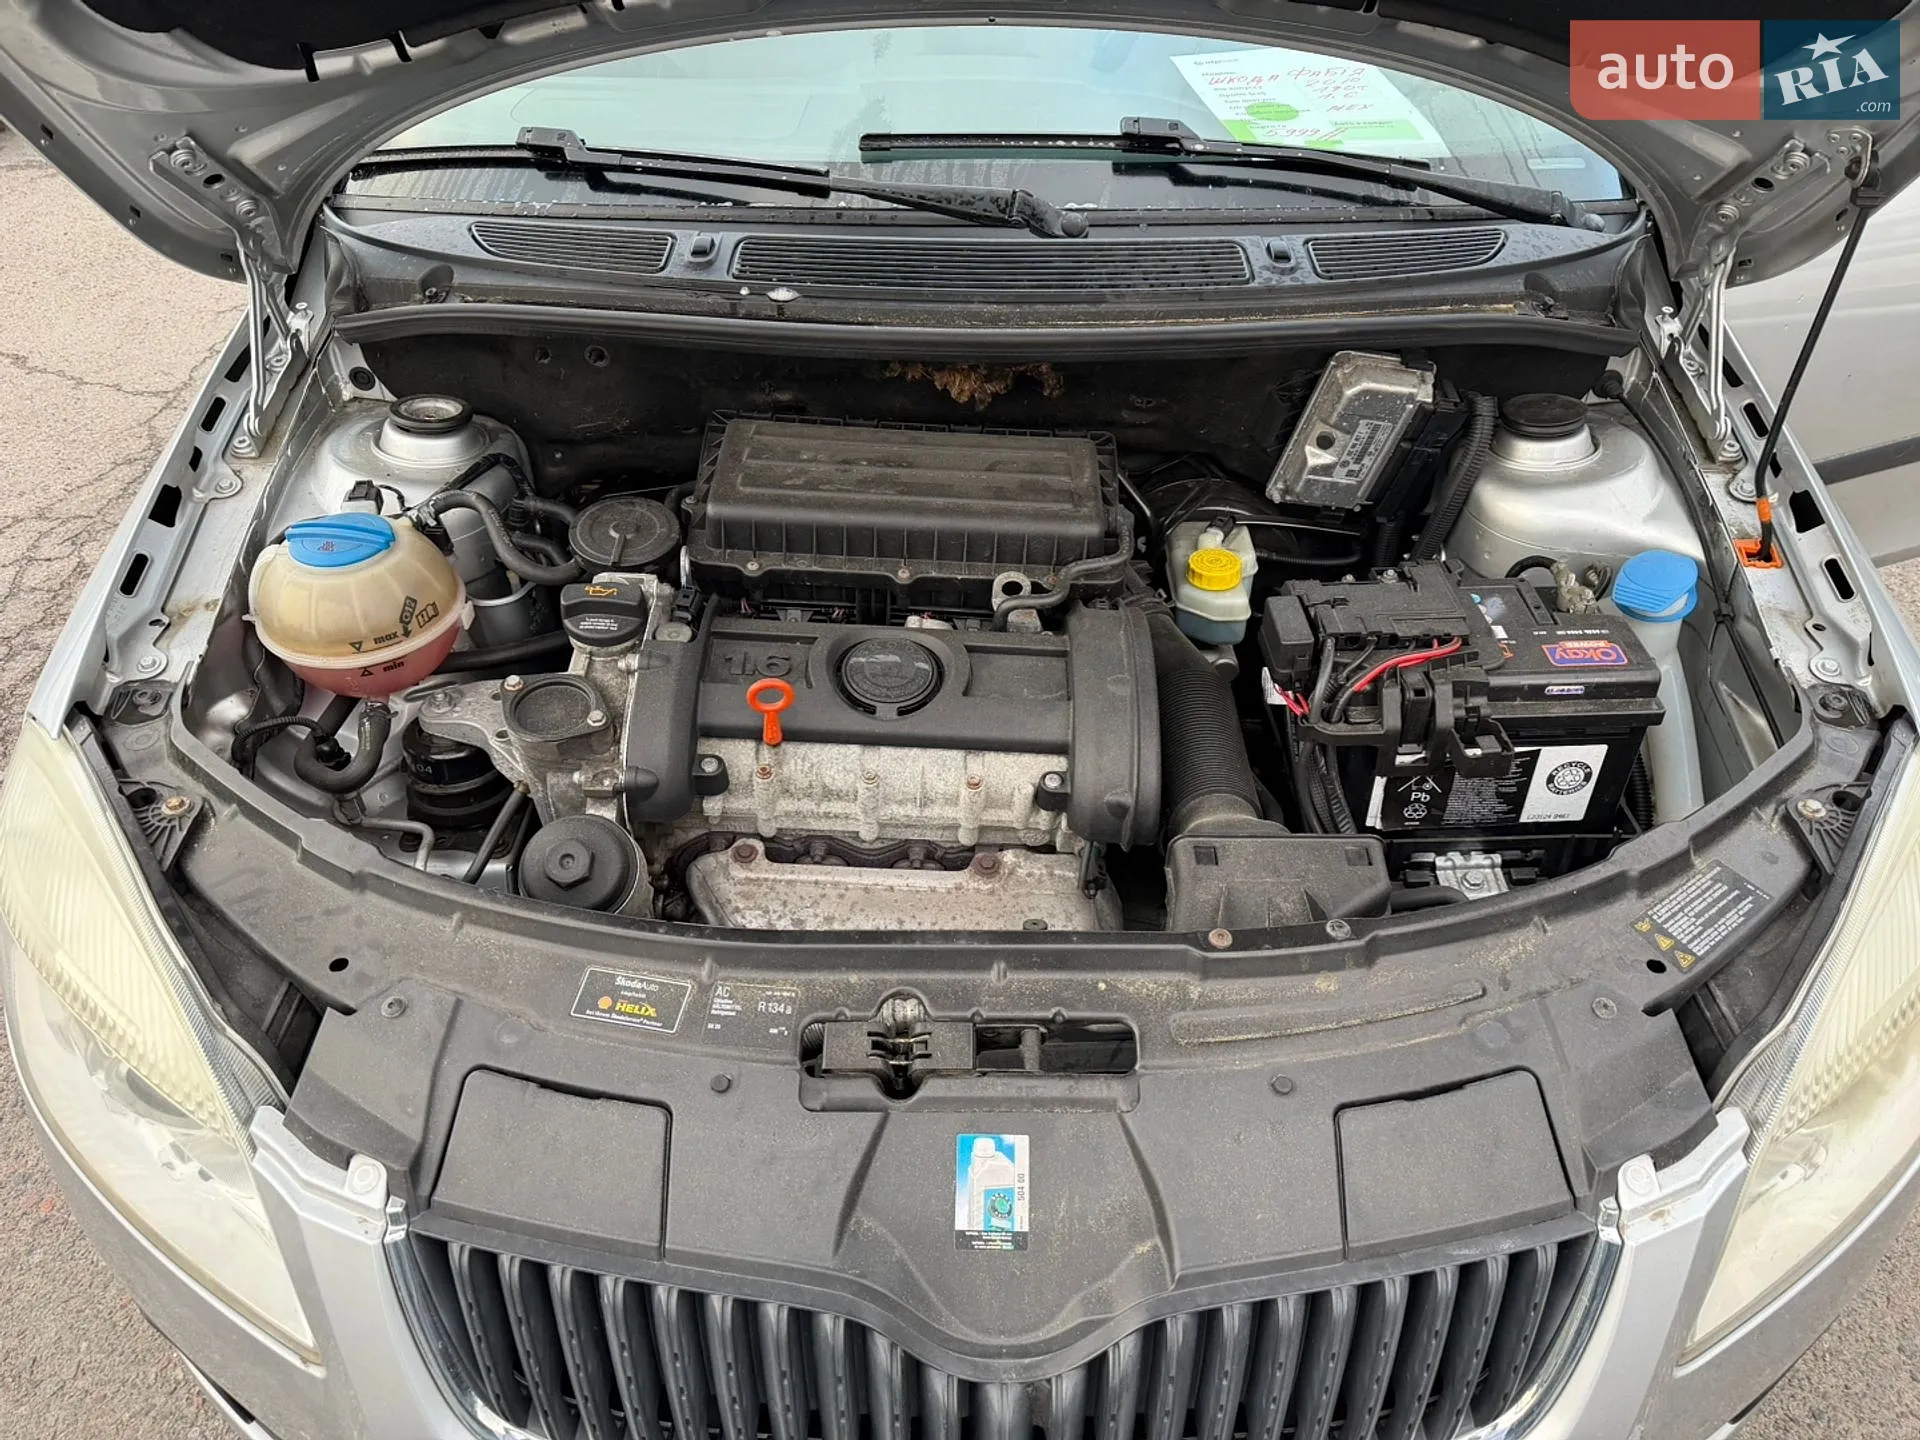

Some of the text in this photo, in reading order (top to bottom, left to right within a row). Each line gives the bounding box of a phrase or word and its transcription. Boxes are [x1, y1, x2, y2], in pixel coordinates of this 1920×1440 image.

[373, 631, 400, 645] max
[1555, 646, 1617, 661] Okay
[382, 661, 405, 673] min
[1410, 792, 1431, 802] Pb
[715, 986, 731, 998] AC
[614, 1001, 658, 1018] HELIX
